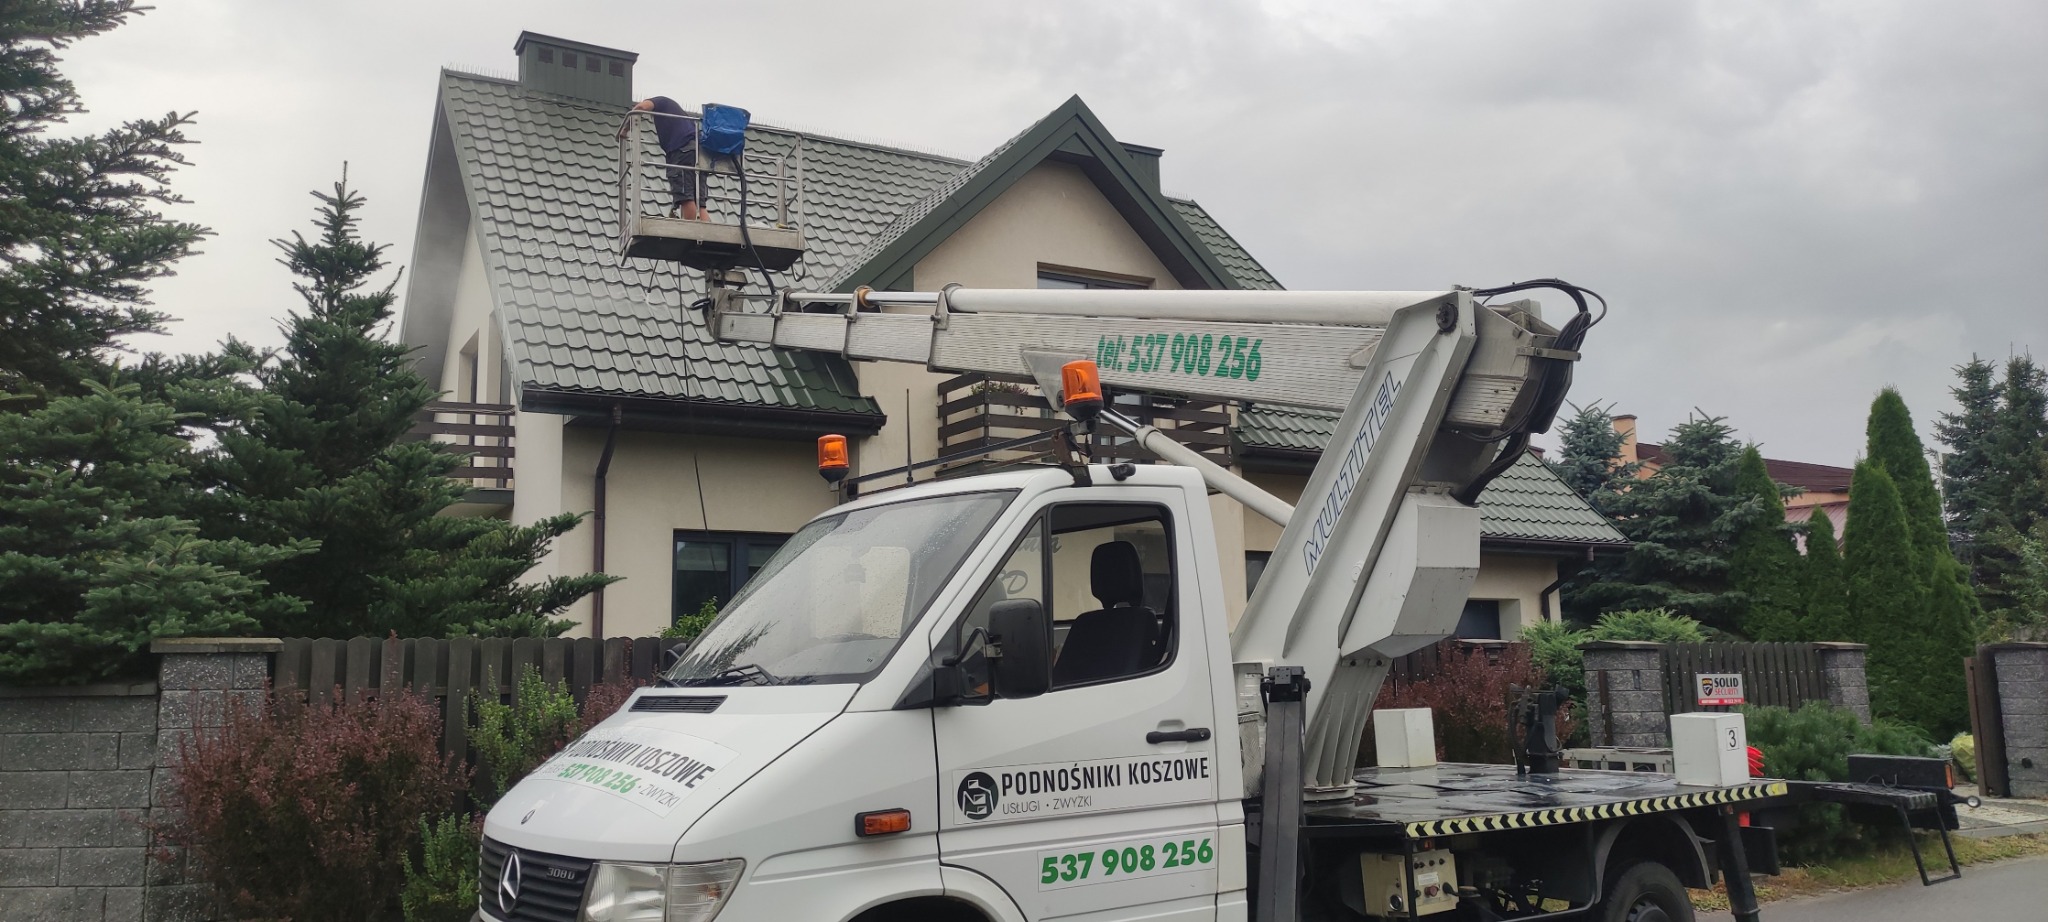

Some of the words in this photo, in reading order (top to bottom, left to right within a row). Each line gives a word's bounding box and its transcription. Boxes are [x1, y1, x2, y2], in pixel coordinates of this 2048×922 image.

[1096, 334, 1126, 372] tel:
[1127, 333, 1169, 373] 537
[1170, 333, 1213, 376] 908
[1214, 335, 1263, 382] 256
[1302, 371, 1402, 577] MULTITEL
[1714, 677, 1739, 688] SOLID
[1728, 729, 1738, 748] 3
[557, 763, 590, 779] 537
[578, 765, 614, 784] 908
[602, 771, 642, 794] 256
[626, 746, 716, 790] KOSZOWE
[1002, 763, 1122, 797] PODNOŚNIKI
[1128, 757, 1210, 785] KOSZOWE
[1002, 801, 1041, 815] USŁUGI
[1041, 852, 1095, 884] 537
[1101, 845, 1156, 876] 908
[1162, 838, 1213, 868] 256
